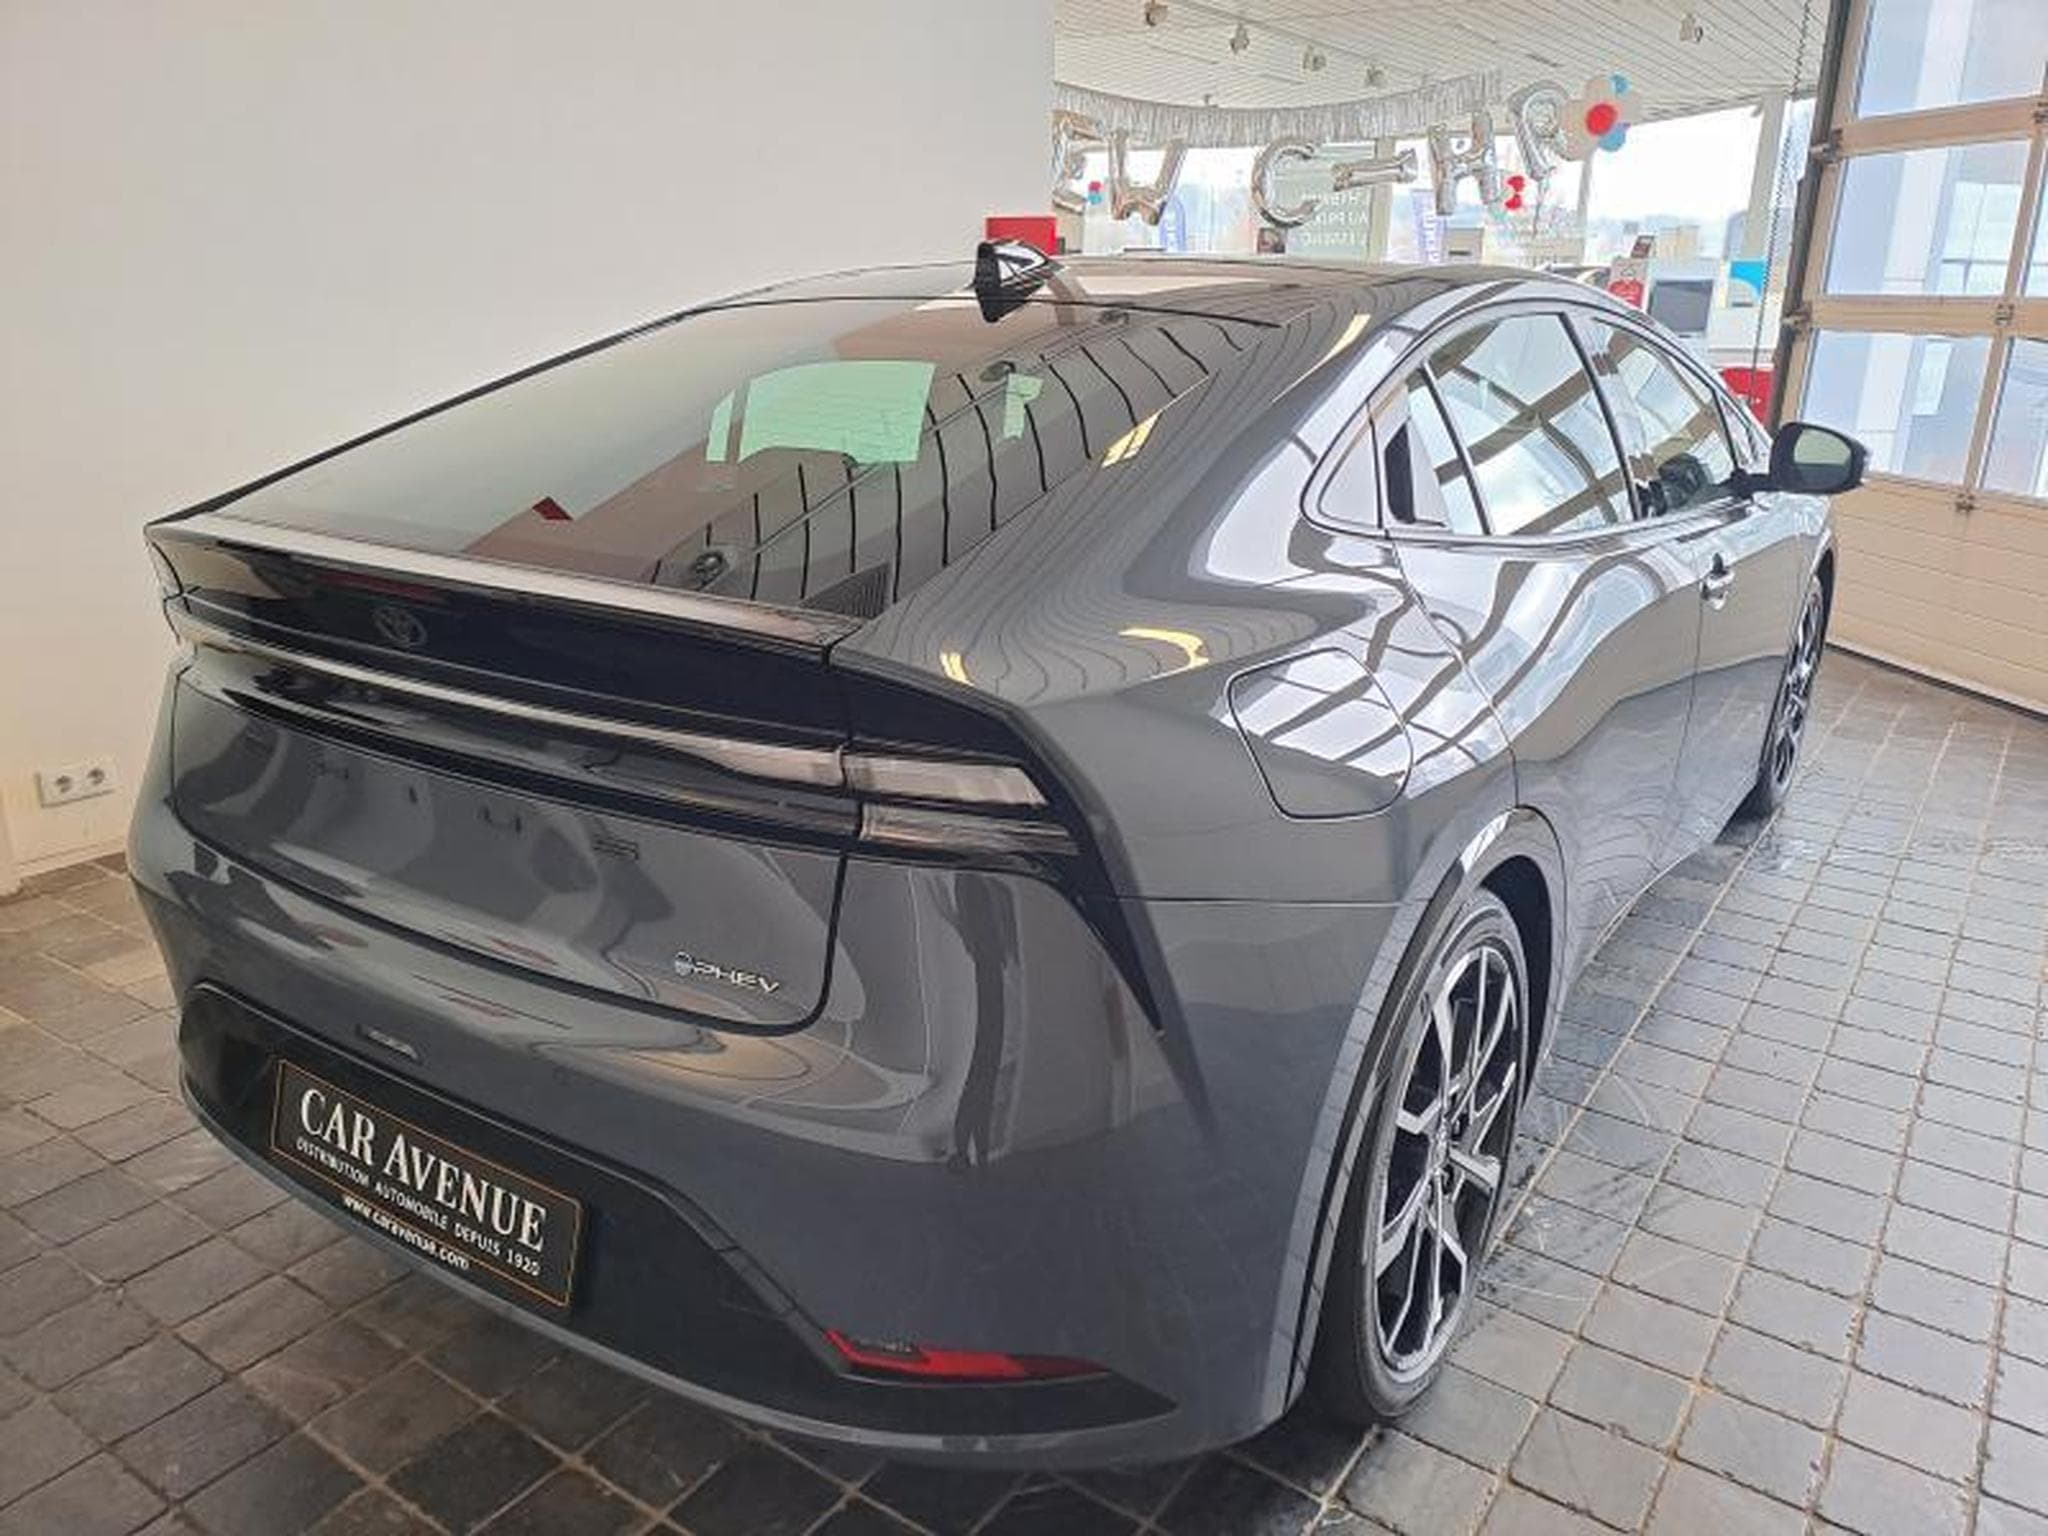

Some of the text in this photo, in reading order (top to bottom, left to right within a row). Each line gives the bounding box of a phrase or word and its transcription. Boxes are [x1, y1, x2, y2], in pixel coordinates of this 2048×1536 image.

[694, 960, 780, 993] PHEV
[296, 1135, 541, 1277] DISTRIBUTION AUTOMOBILE DEPUIS 1920
[301, 1088, 547, 1253] CAR AVENUE
[343, 1195, 470, 1271] www.caravenue.com
